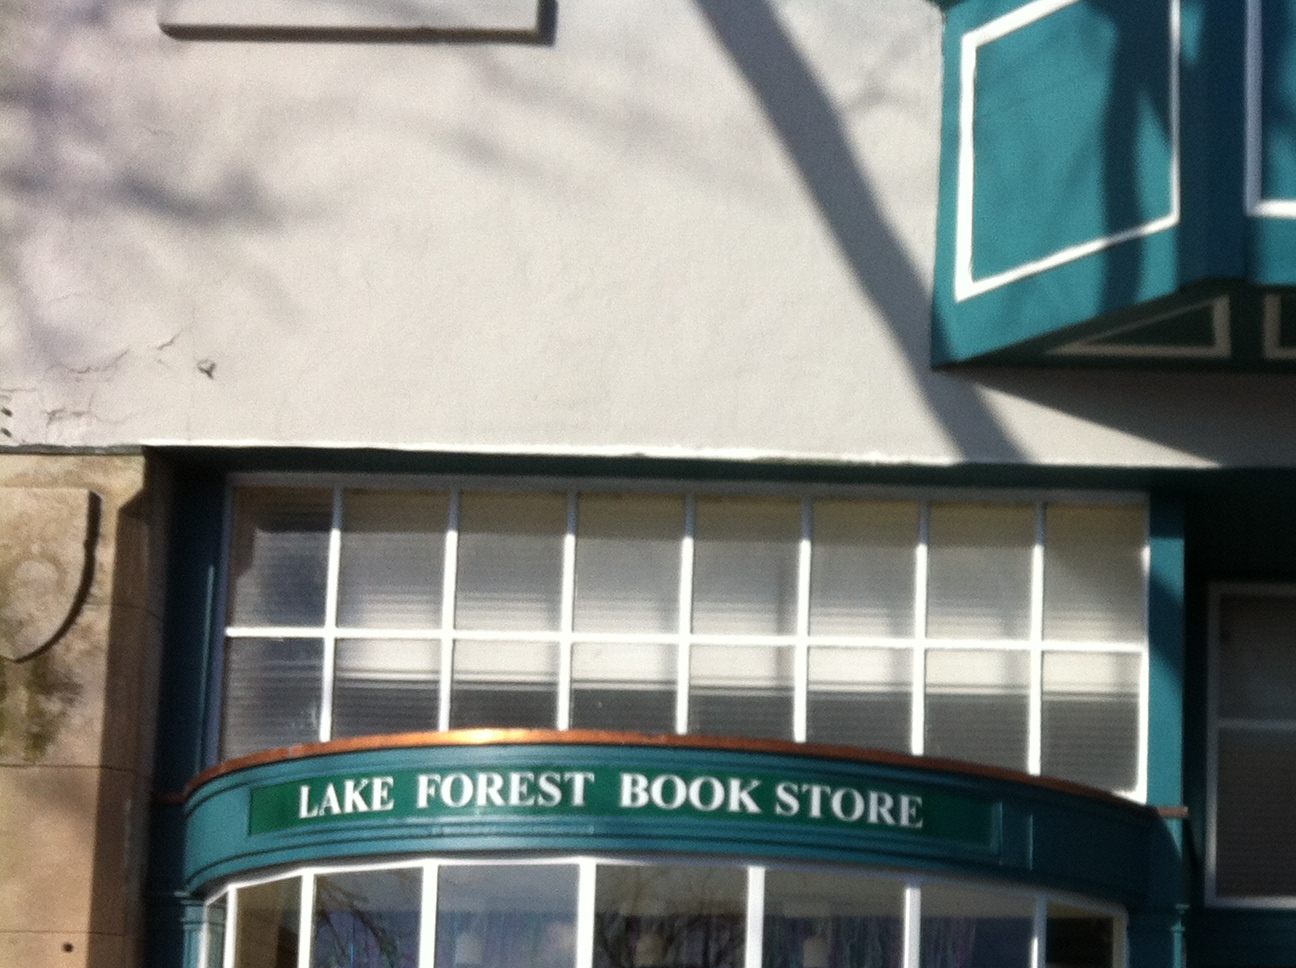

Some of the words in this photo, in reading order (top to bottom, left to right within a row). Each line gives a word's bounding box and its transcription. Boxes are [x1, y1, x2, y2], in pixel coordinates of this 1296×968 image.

[298, 775, 395, 819] LAKE
[415, 770, 596, 809] FOREST
[618, 772, 763, 815] BOOK
[773, 782, 925, 829] STORE
